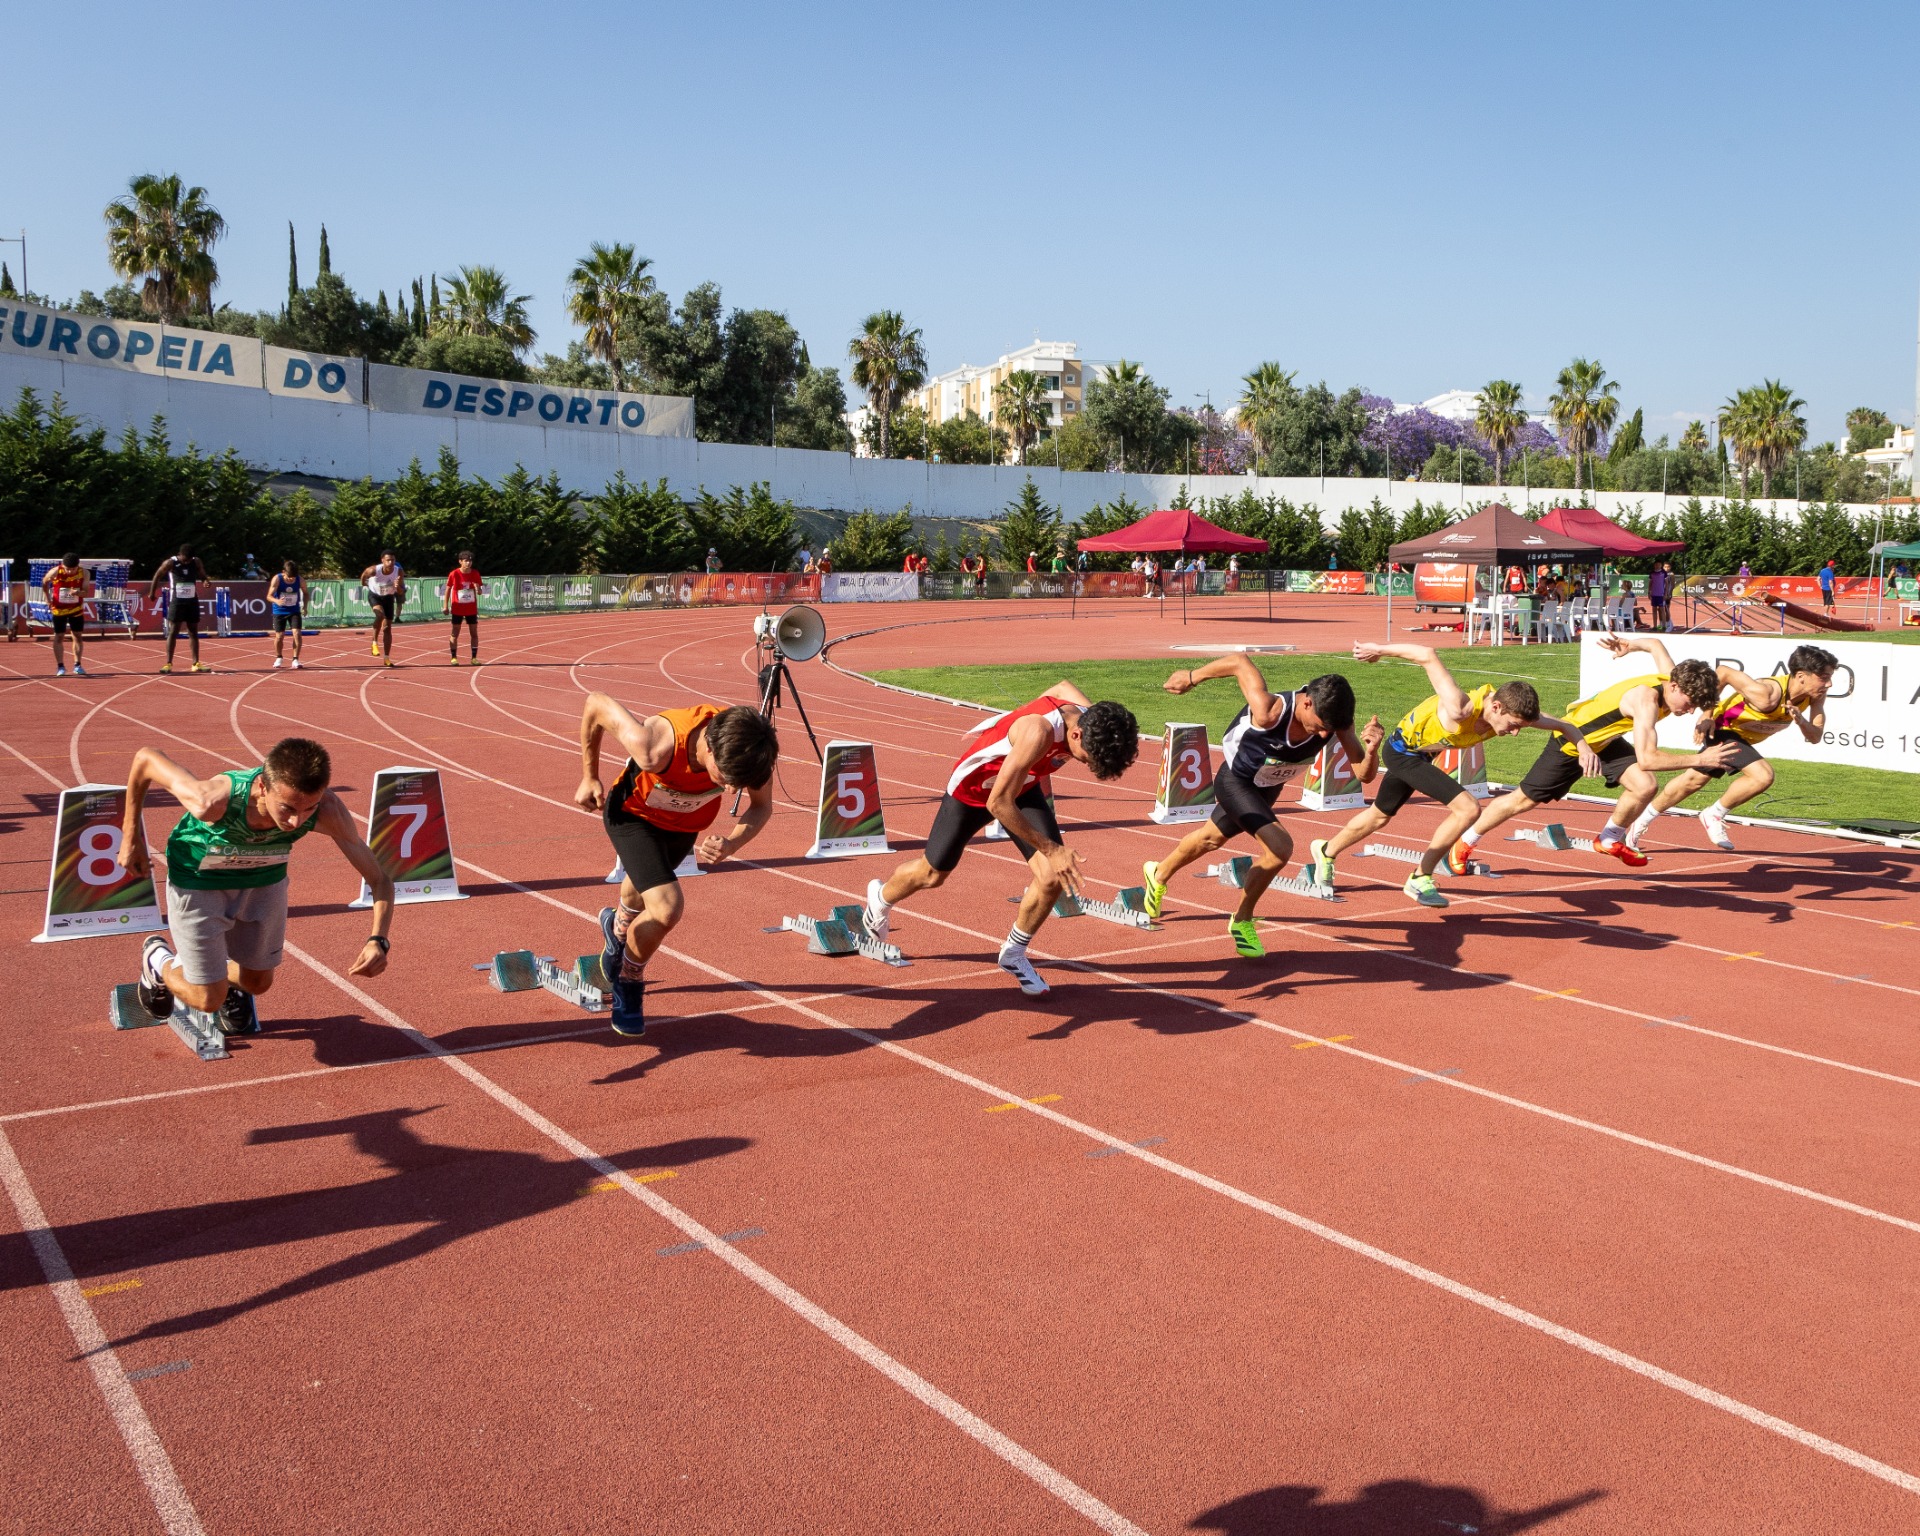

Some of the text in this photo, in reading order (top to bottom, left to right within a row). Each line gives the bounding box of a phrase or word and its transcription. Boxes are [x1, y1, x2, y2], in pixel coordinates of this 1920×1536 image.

[0, 307, 646, 428] UROPEIA DO DESPORTO
[492, 582, 511, 600] CA
[564, 583, 593, 597] MAIS
[839, 577, 900, 587] RADIANT
[1040, 581, 1065, 593] Vitalis
[1393, 576, 1409, 589] CA
[1717, 582, 1729, 591] CA
[310, 586, 336, 609] CA
[627, 588, 652, 602] Vitalis
[1805, 729, 1885, 749] esde
[1180, 748, 1202, 790] 3
[1333, 741, 1351, 779] 2
[837, 772, 865, 819] 5
[389, 804, 428, 858] 7
[77, 824, 128, 886] 8
[223, 846, 239, 856] CA
